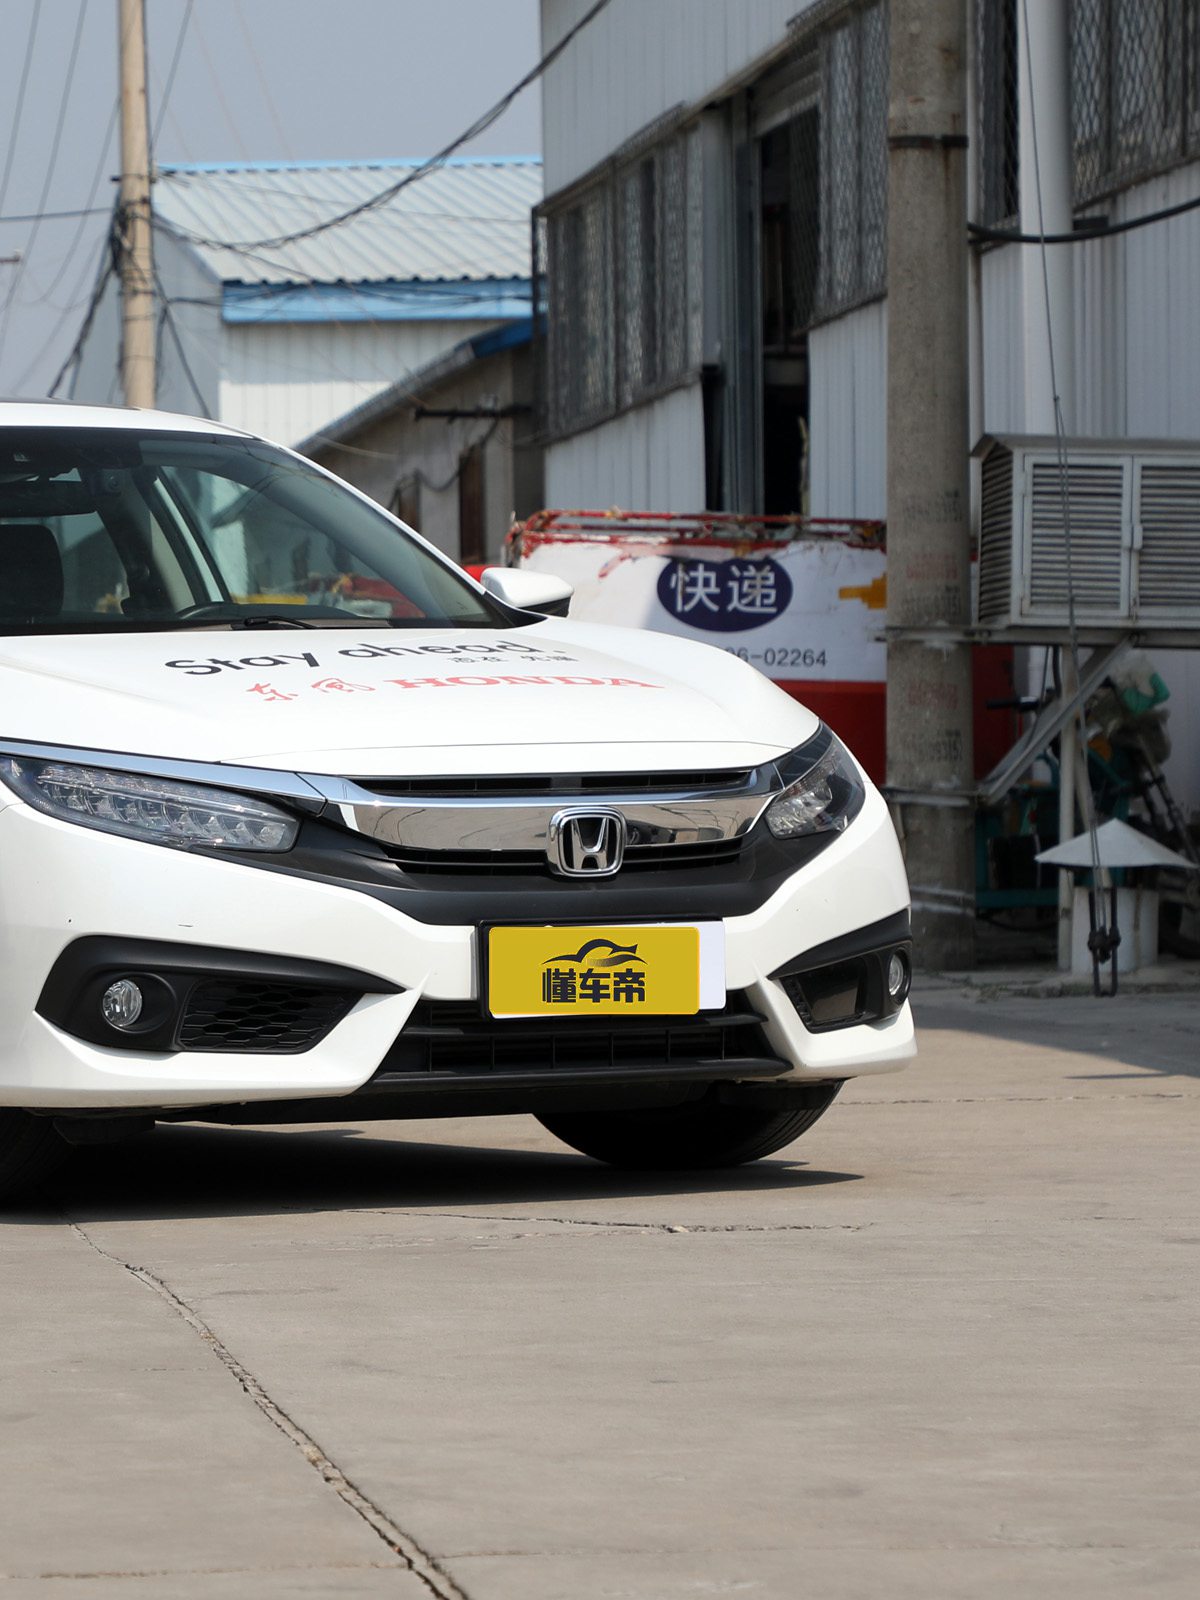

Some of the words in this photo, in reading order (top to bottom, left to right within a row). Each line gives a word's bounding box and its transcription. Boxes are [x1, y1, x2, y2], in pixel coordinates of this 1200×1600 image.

[670, 563, 778, 613] 快递
[165, 652, 320, 675] Stay
[383, 675, 665, 690] HONDA
